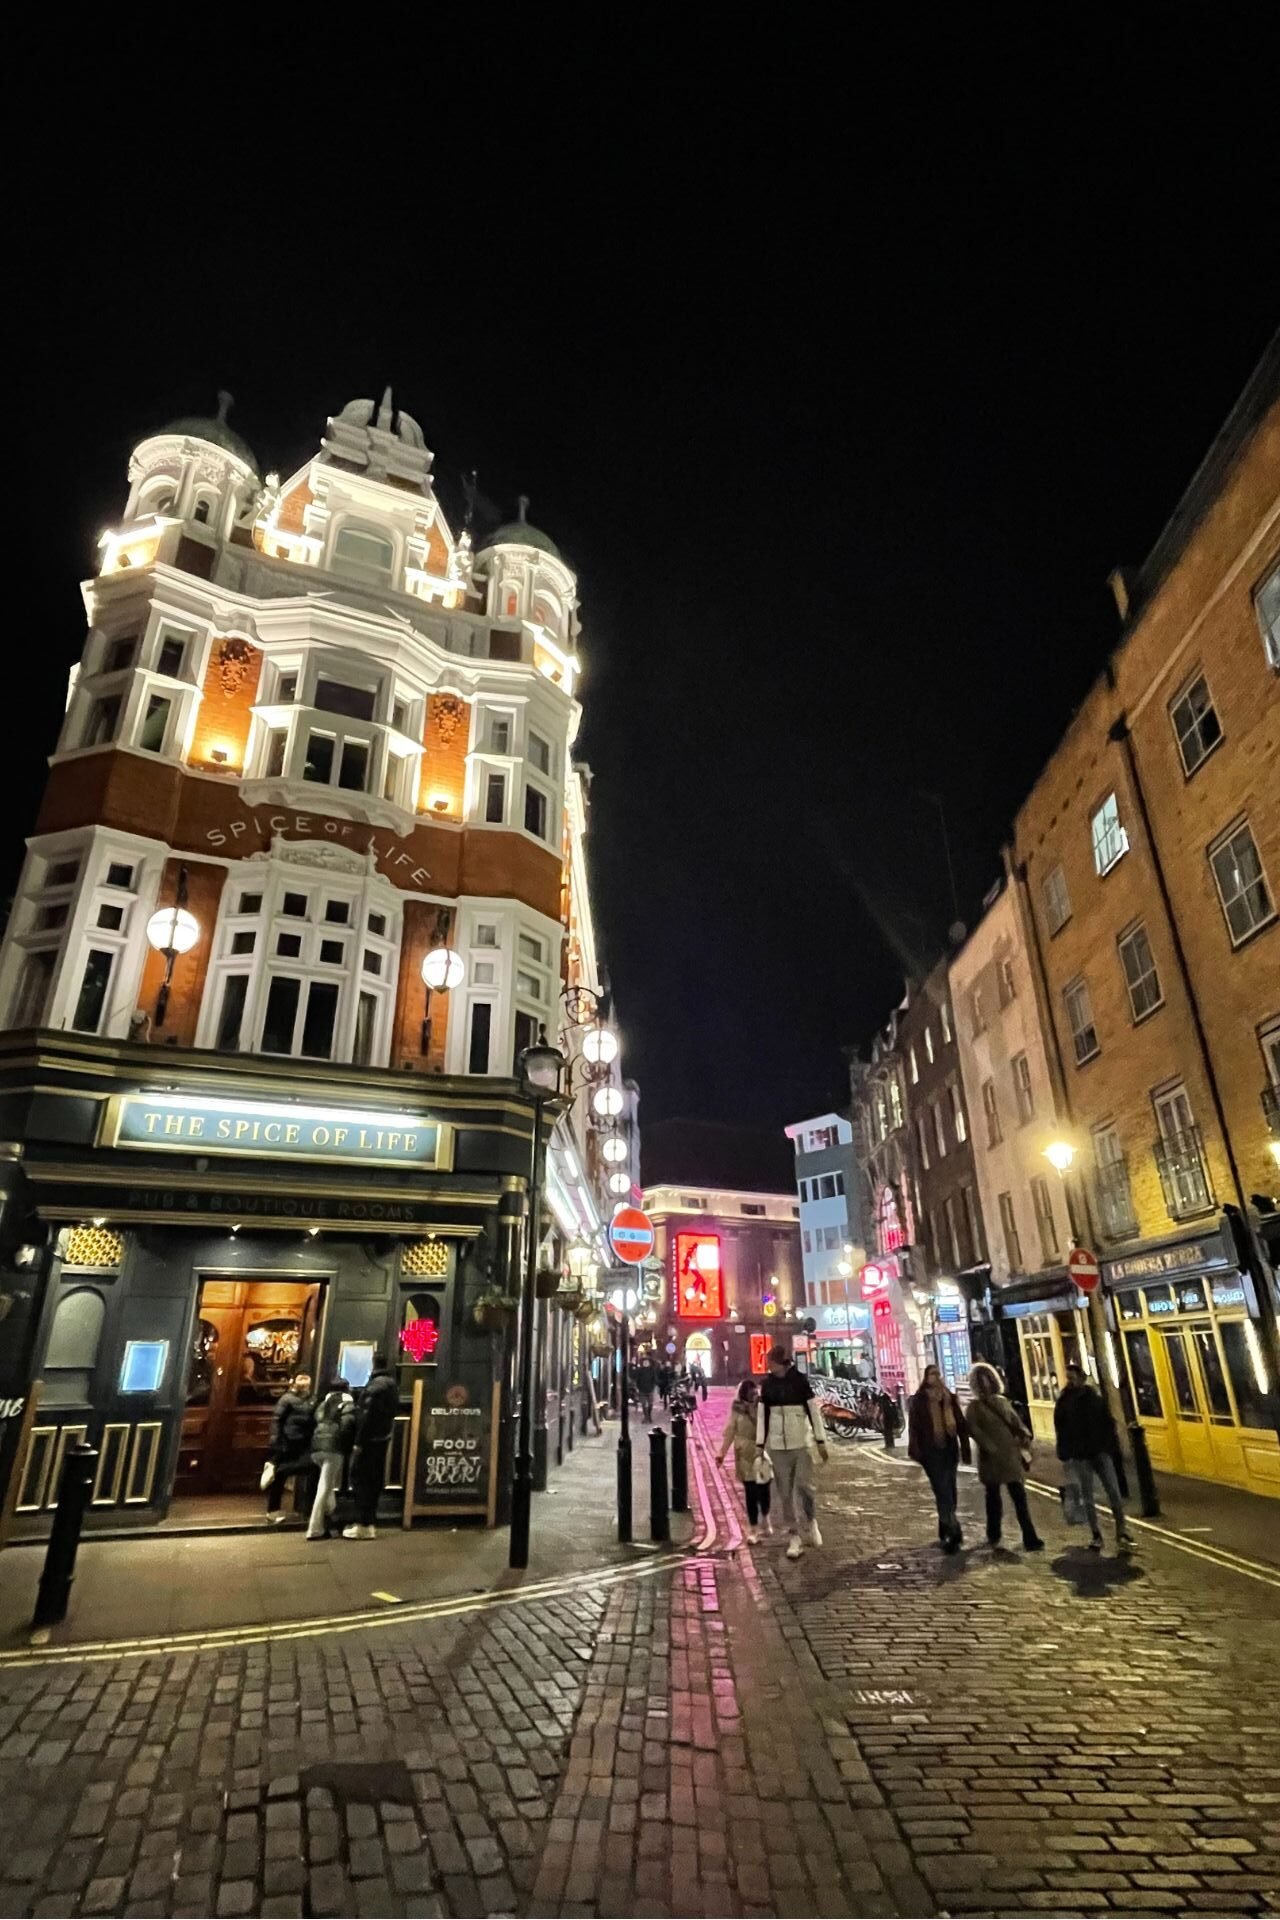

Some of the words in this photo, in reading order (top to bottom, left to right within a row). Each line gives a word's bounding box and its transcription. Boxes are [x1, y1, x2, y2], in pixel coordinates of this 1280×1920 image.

[205, 815, 312, 847] SPICE
[324, 821, 353, 836] OF
[368, 835, 431, 886] LIFE
[144, 1113, 206, 1138] THE
[216, 1119, 301, 1144] SPICE
[312, 1126, 349, 1147] OF
[360, 1129, 418, 1153] LIFE
[128, 1191, 175, 1209] PUB
[209, 1196, 328, 1216] BOUTIQUE
[337, 1202, 416, 1221] ROOMS
[409, 1319, 434, 1331] LIVE
[430, 1407, 482, 1416] DELICIOUS
[432, 1438, 477, 1450] FOOD
[426, 1456, 481, 1466] GREAT
